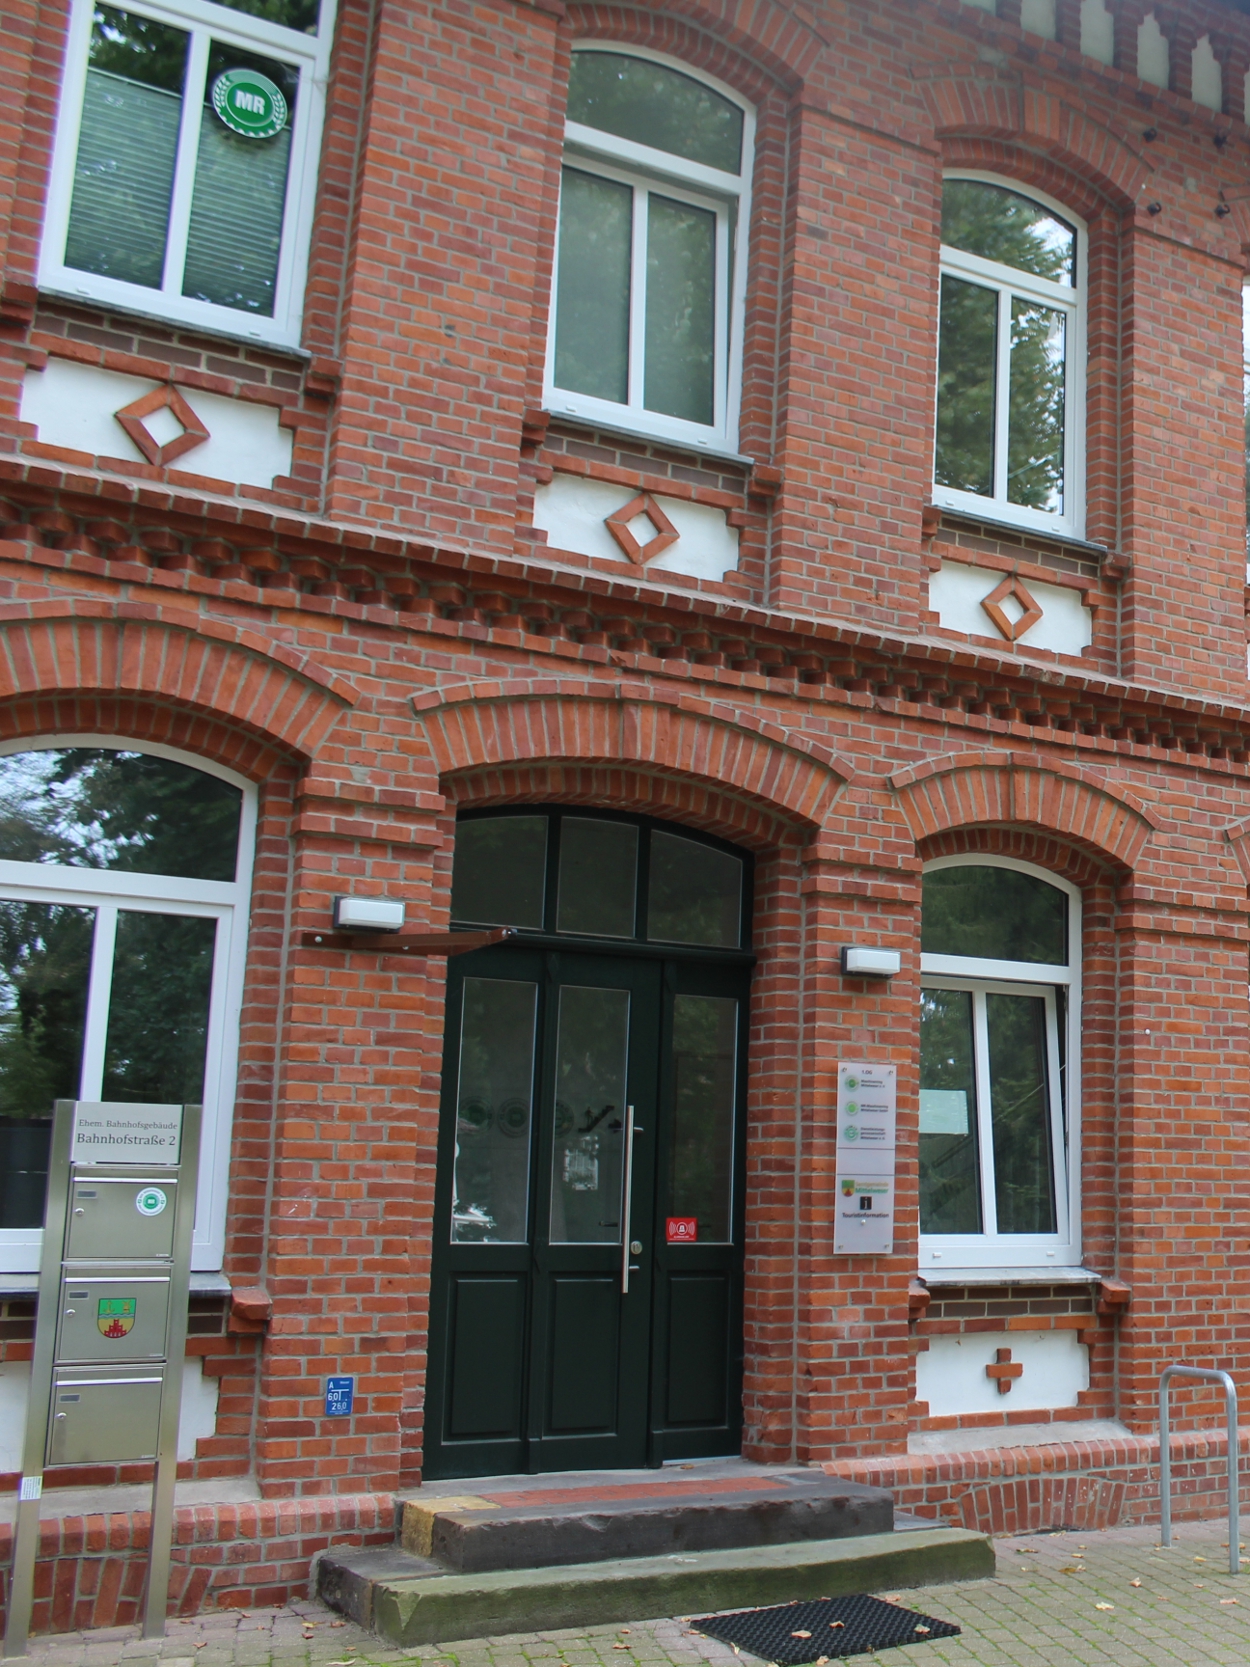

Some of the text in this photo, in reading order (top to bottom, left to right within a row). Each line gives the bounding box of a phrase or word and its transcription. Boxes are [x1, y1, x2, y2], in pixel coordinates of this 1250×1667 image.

[235, 89, 265, 116] MR
[79, 1119, 178, 1130] Ehem. Bahnhofsgebäude
[77, 1132, 176, 1146] Bahnhofstraße 2
[329, 1381, 334, 1389] A
